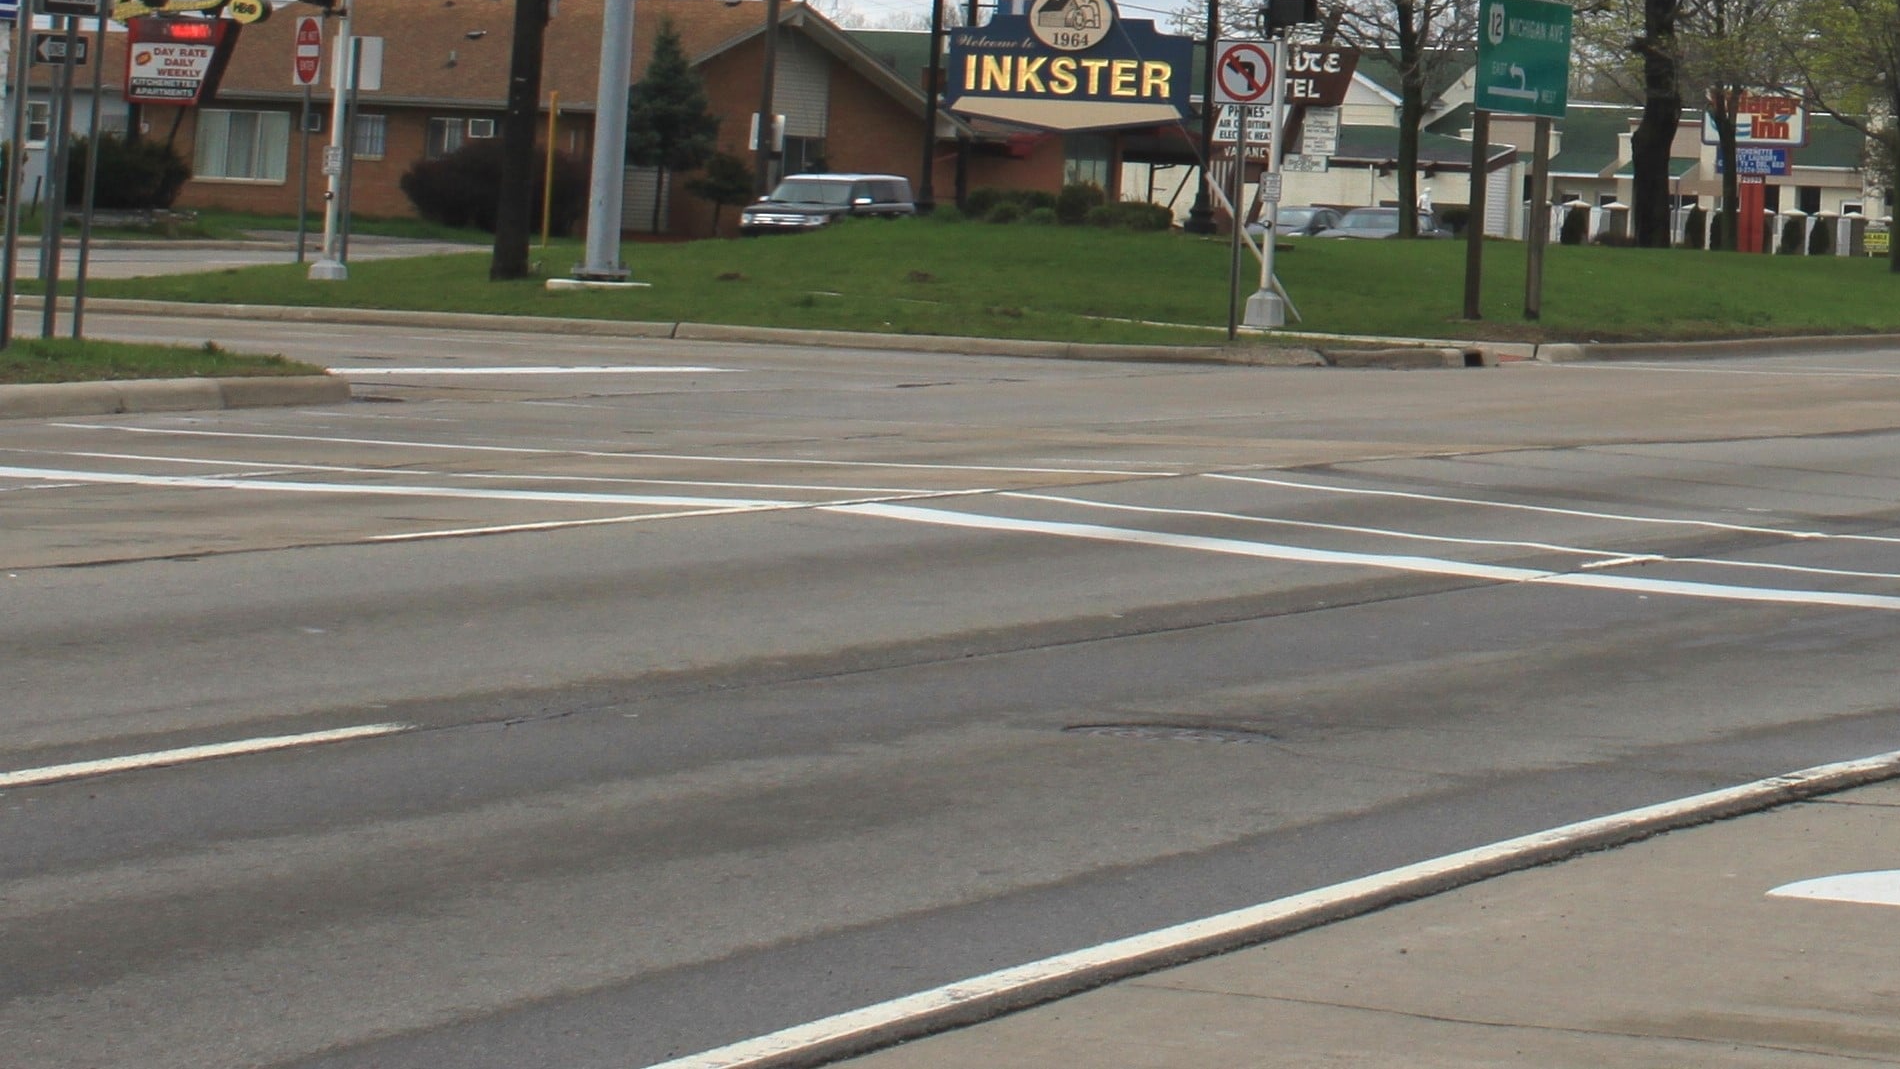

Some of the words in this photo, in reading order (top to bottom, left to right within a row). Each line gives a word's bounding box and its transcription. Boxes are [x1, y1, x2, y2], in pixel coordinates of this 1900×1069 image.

[1492, 12, 1503, 37] 12
[1508, 18, 1546, 41] MICHIGAN
[1053, 32, 1089, 47] 1964
[154, 47, 174, 56] DAY
[179, 49, 207, 58] RATE
[164, 58, 195, 67] DAILY
[157, 67, 201, 78] WEEKLY
[965, 54, 1172, 99] INKSTER
[132, 78, 198, 88] KITCHENETTES
[135, 87, 193, 97] APARTMENTS
[1751, 114, 1789, 139] Inn
